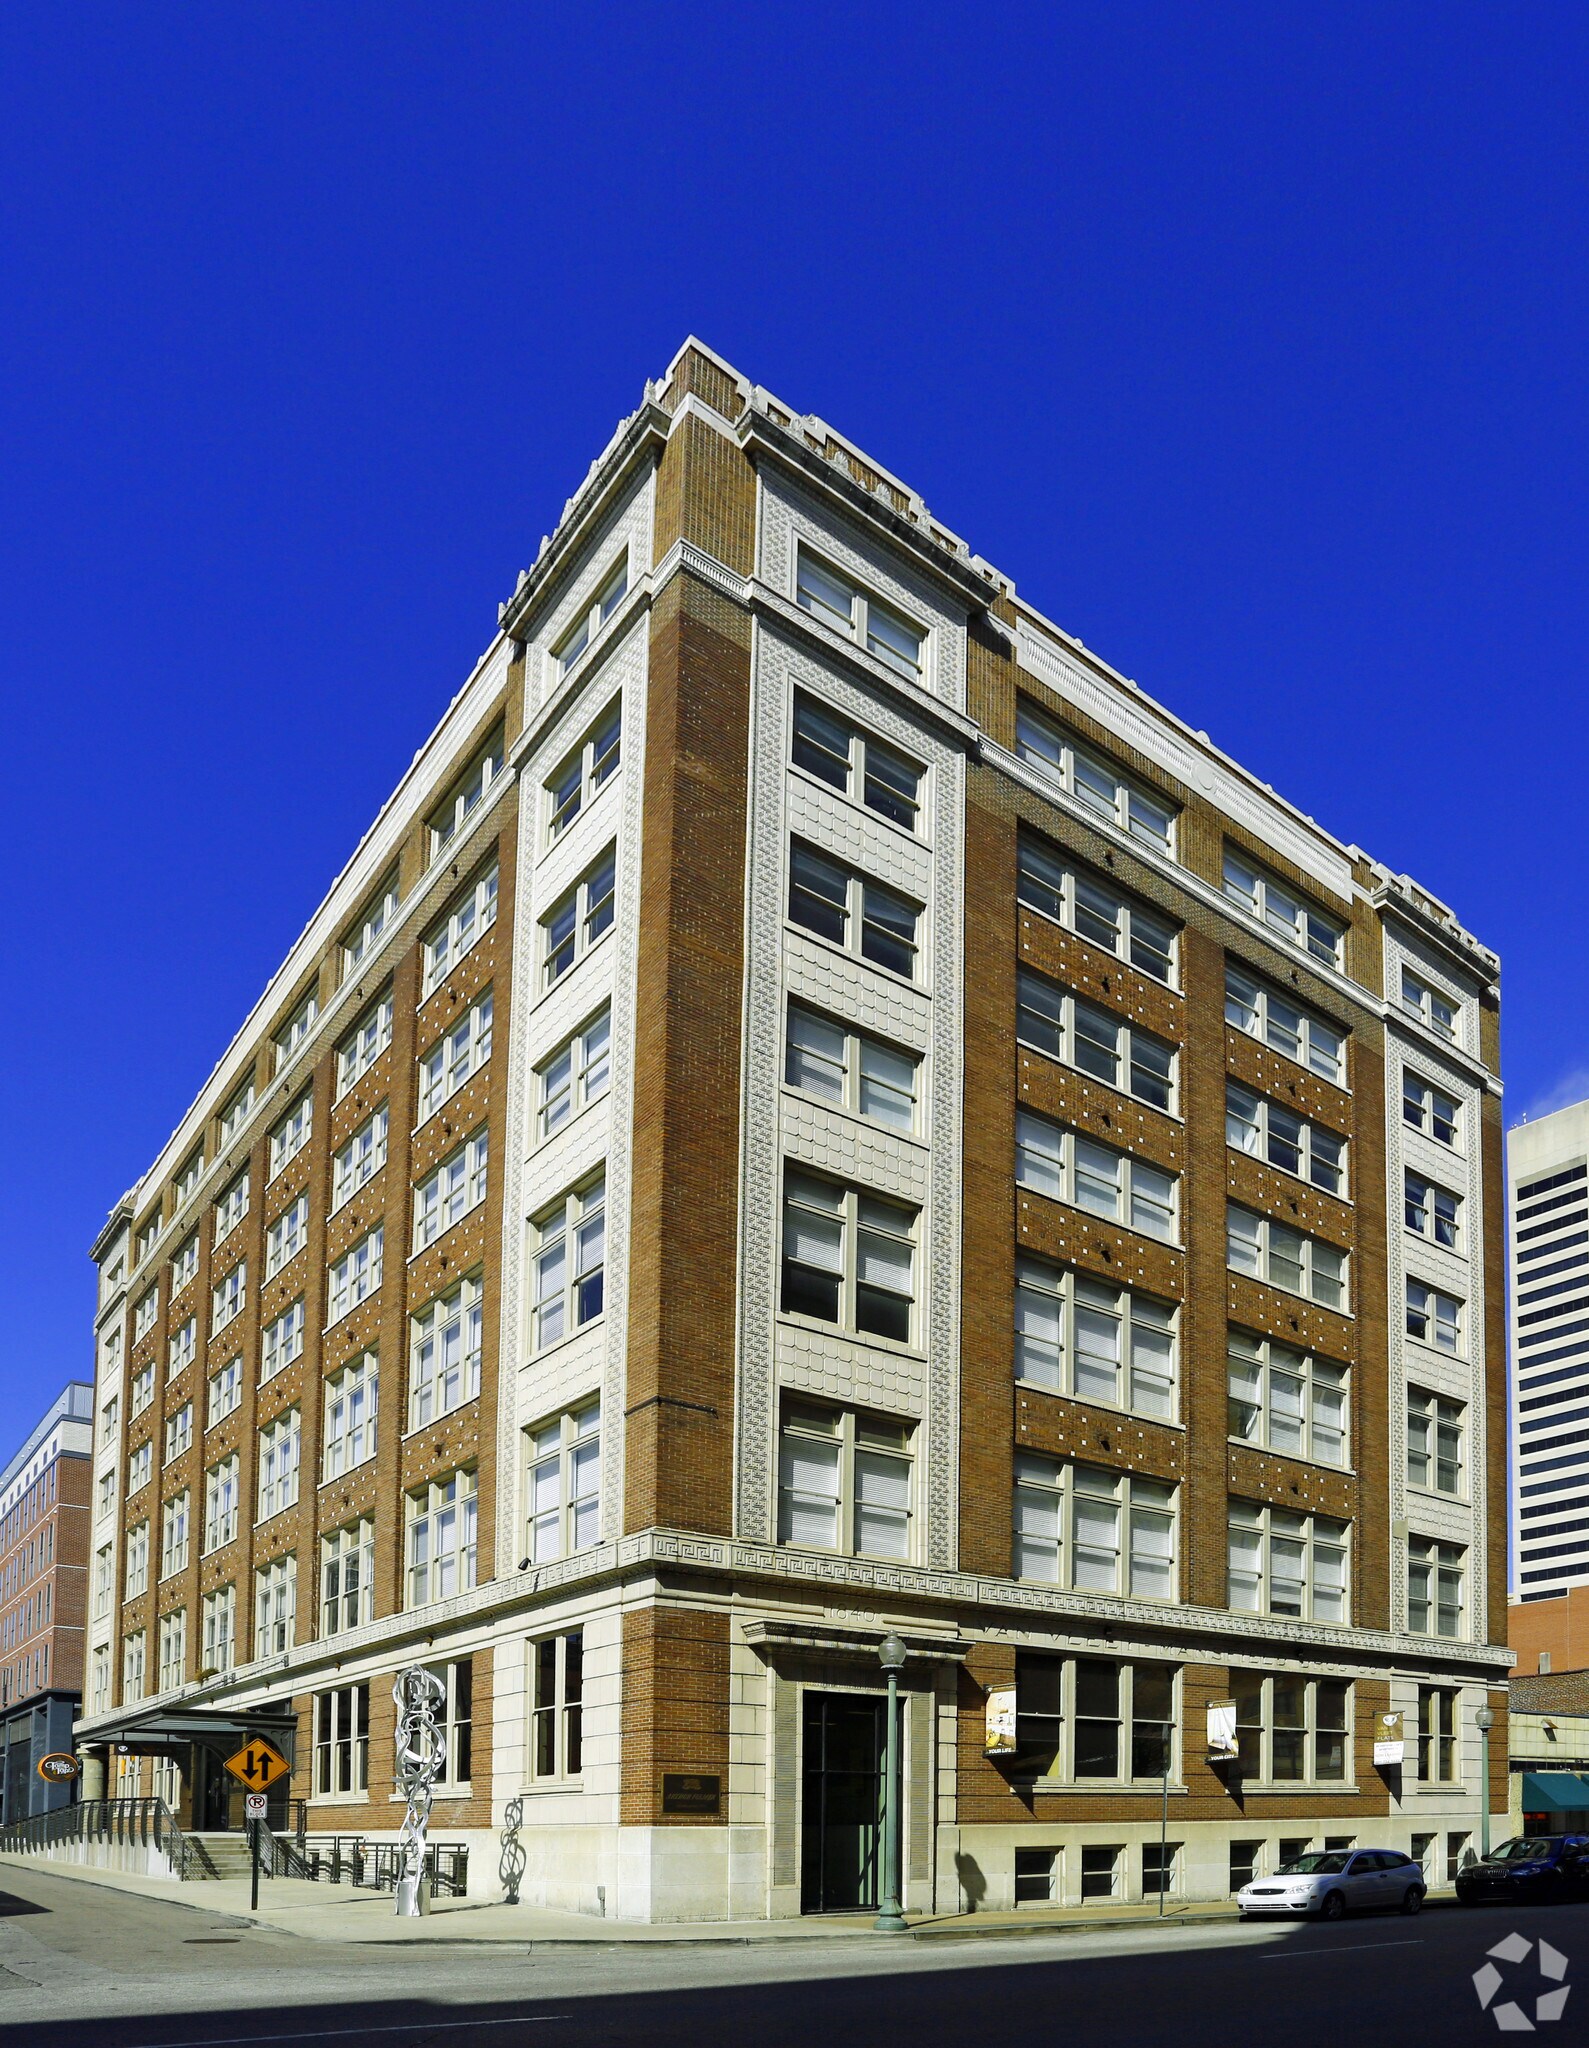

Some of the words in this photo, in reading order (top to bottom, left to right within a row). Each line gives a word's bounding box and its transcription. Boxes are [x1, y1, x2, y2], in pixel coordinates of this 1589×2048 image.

[829, 1602, 876, 1623] 1840
[976, 1620, 1031, 1641] VAN
[1298, 1654, 1348, 1672] DRUG
